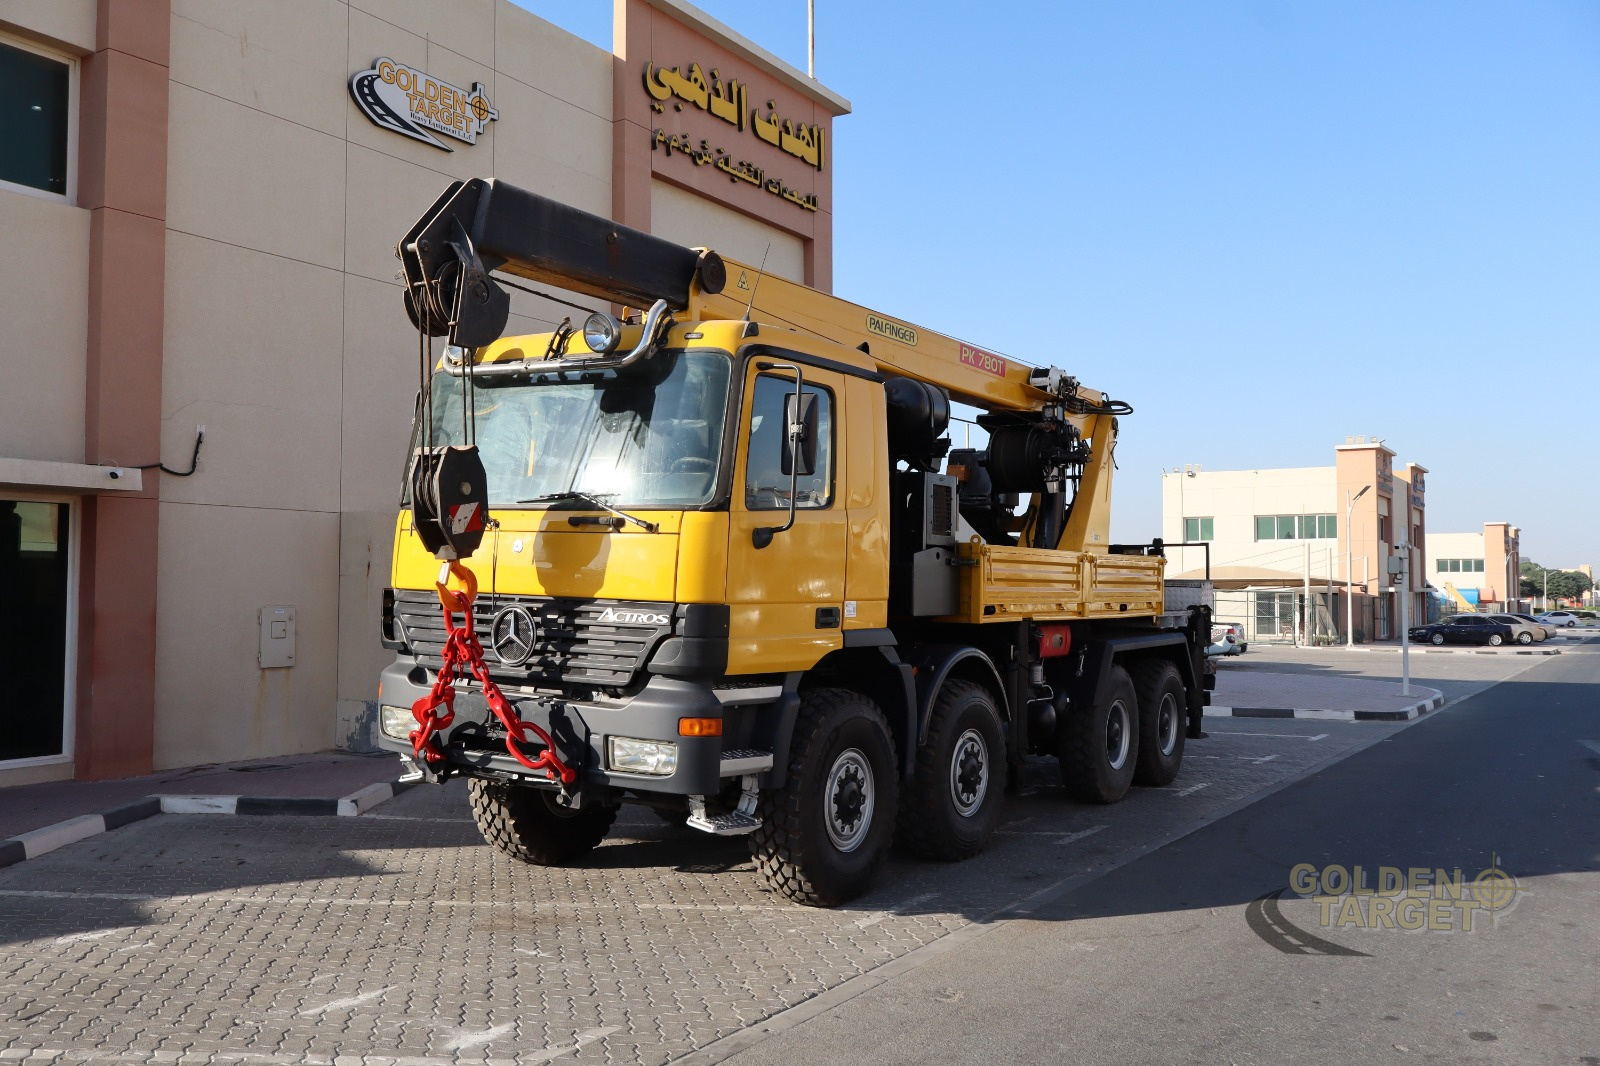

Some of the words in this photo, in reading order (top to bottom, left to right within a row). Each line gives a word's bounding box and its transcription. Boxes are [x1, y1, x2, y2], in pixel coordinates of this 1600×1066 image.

[379, 62, 467, 114] GOLDEN
[643, 60, 748, 131] الذهبي
[406, 93, 474, 133] TARGET
[410, 112, 427, 124] Heavy
[428, 119, 457, 135] Equipment
[753, 99, 826, 170] الهدف
[714, 147, 765, 188] الثقيلة
[766, 178, 819, 212] للمعدات
[869, 316, 915, 343] PALFINGER
[962, 346, 976, 365] PK
[978, 352, 1004, 374] 780T
